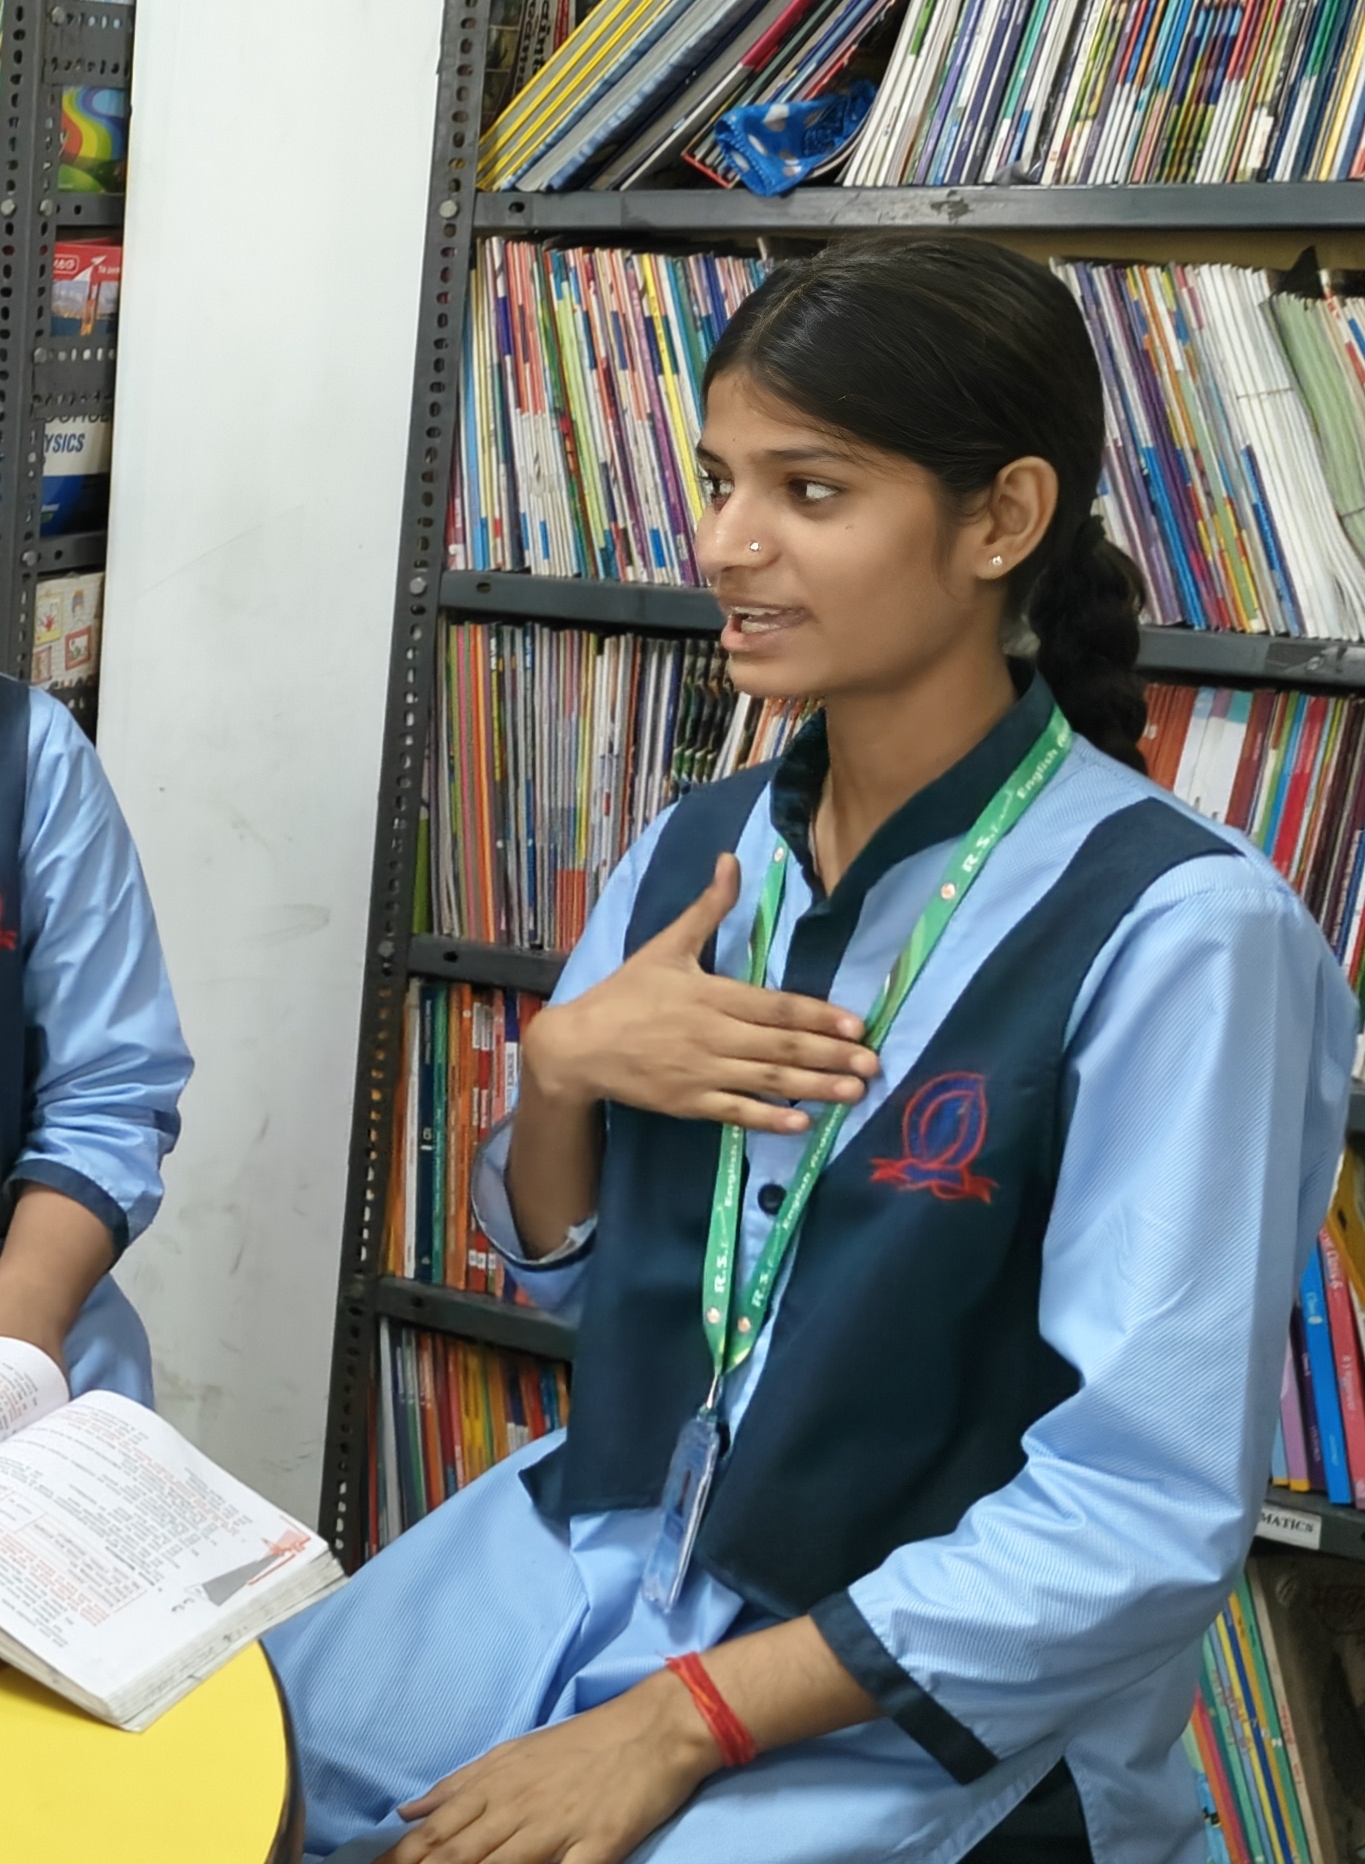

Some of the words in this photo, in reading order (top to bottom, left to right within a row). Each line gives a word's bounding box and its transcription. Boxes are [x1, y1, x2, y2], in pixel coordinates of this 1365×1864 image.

[960, 828, 996, 873] R.S.
[1014, 746, 1059, 800] English
[713, 1248, 729, 1293] R.S.
[722, 1145, 739, 1207] English
[749, 1266, 773, 1306] R.S.
[779, 1170, 812, 1230] English
